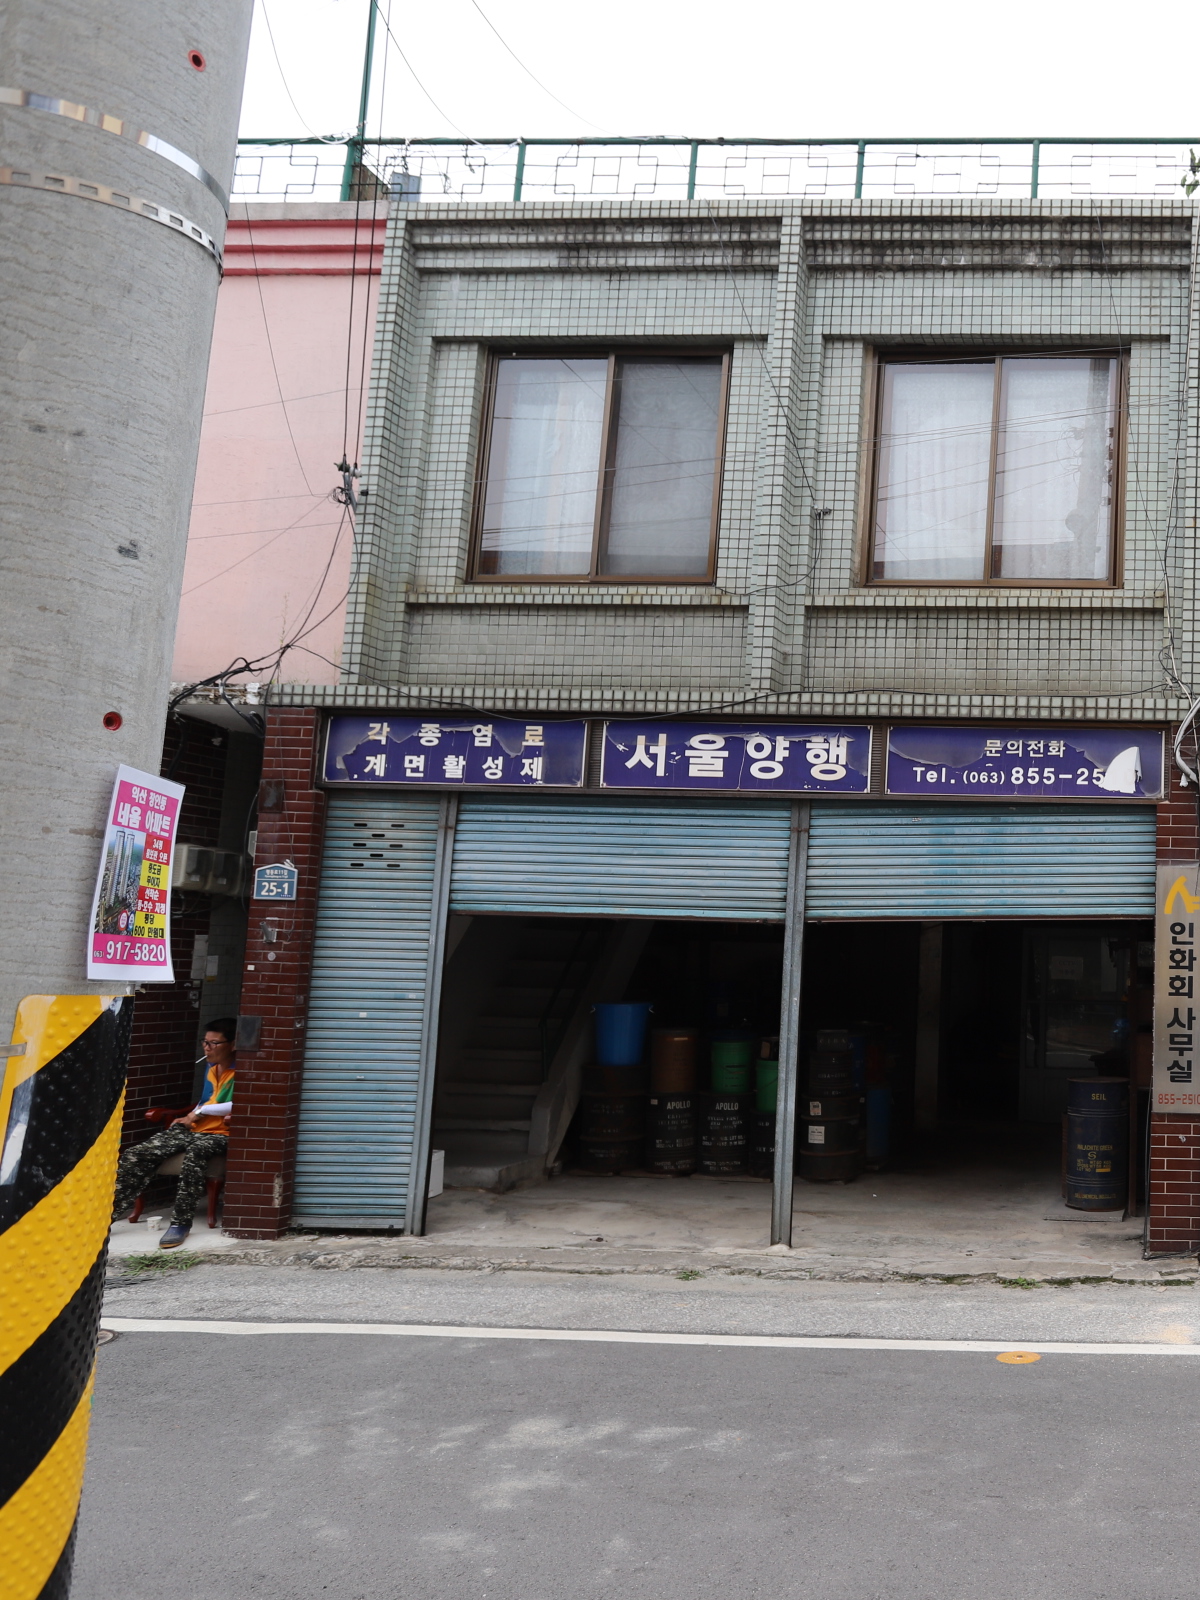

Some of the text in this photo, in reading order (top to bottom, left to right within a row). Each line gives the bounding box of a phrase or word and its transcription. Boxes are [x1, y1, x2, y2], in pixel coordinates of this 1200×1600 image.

[624, 732, 849, 782] 서울양행
[984, 739, 1066, 758] 문의전화
[912, 766, 1106, 786] Tel. (063) 855-25
[131, 786, 148, 805] 익산
[145, 810, 172, 838] 아파트
[260, 881, 289, 896] 25-1
[106, 940, 166, 962] 917-5820
[1166, 922, 1197, 1084] 인화회 사무실
[666, 1100, 691, 1110] APOLLO
[715, 1102, 739, 1111] APOLLO
[1091, 1093, 1107, 1101] SEIL
